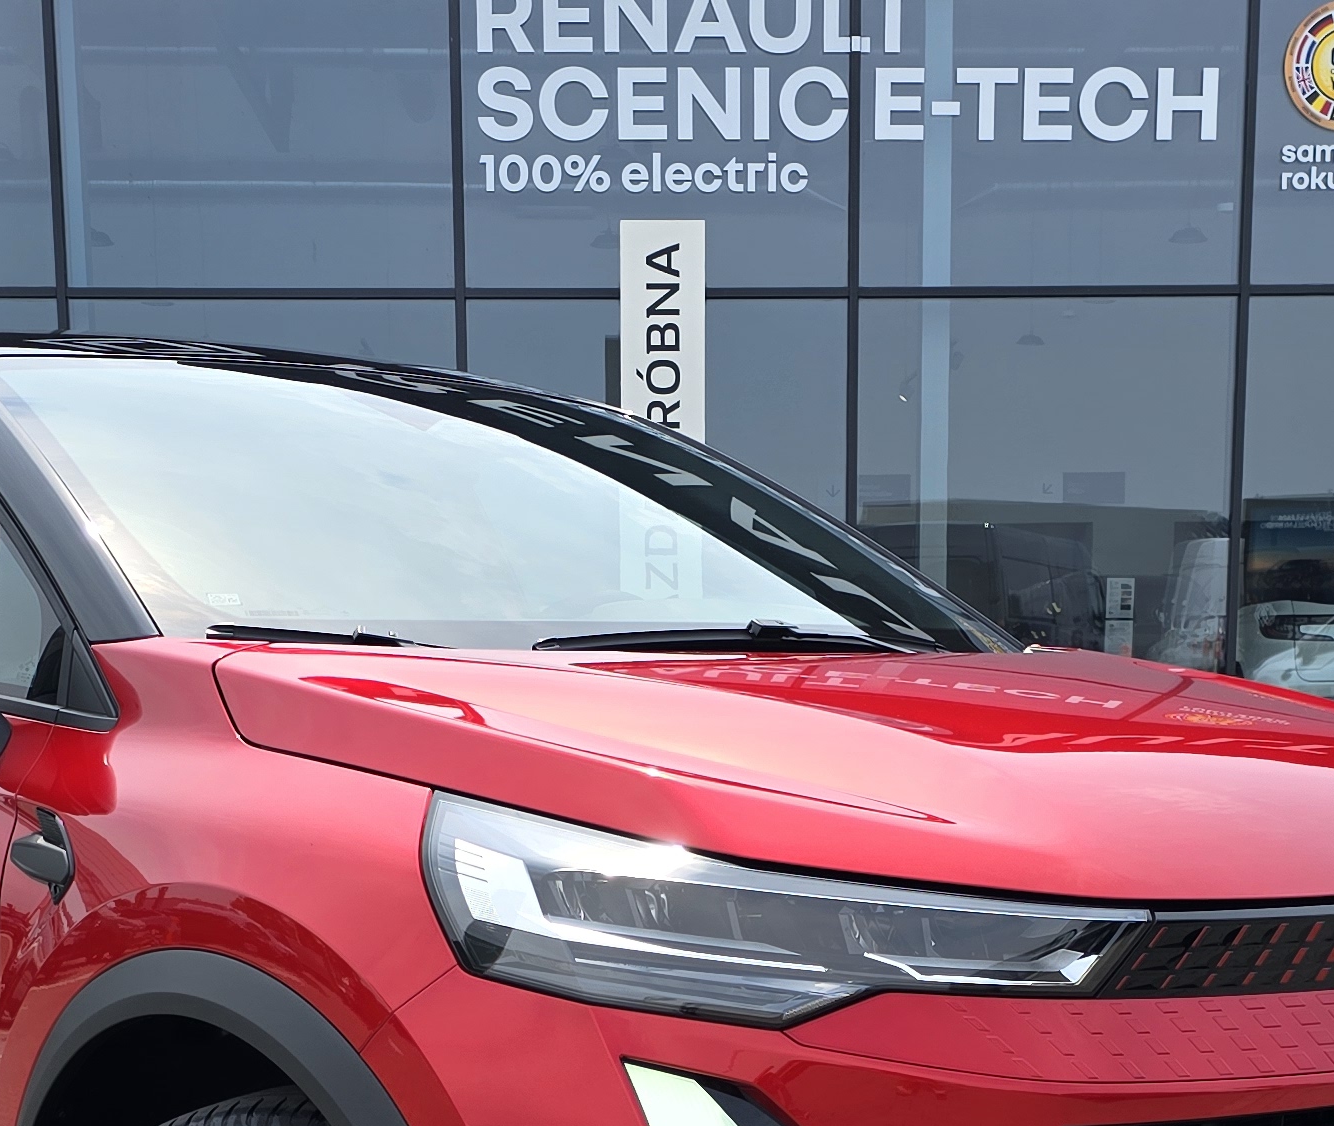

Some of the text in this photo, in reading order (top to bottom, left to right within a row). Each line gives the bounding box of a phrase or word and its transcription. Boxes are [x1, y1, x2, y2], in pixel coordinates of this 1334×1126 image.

[477, 65, 1220, 142] SCENIC E-TECH
[479, 153, 809, 195] 100% electric
[635, 243, 680, 430] RÓBNA
